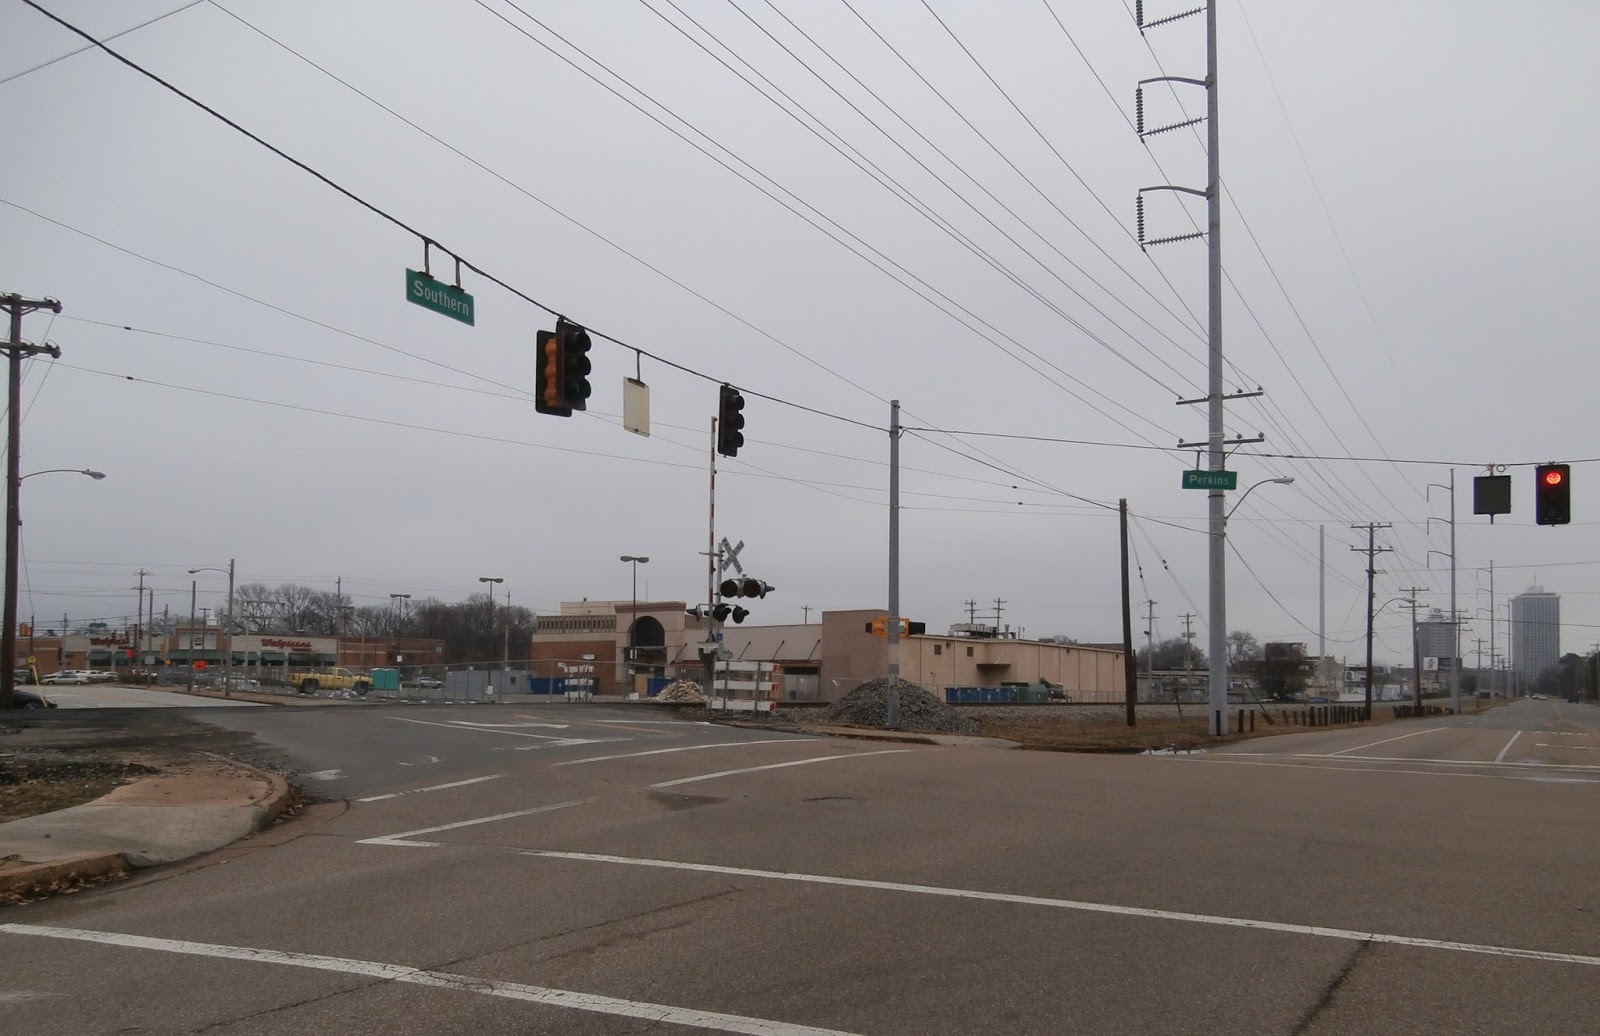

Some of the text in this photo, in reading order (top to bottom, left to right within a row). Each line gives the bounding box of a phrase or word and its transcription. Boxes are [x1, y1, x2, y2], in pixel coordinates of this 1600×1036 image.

[413, 280, 469, 316] Southern
[1189, 475, 1229, 485] Perkins
[261, 639, 312, 649] Walgreens
